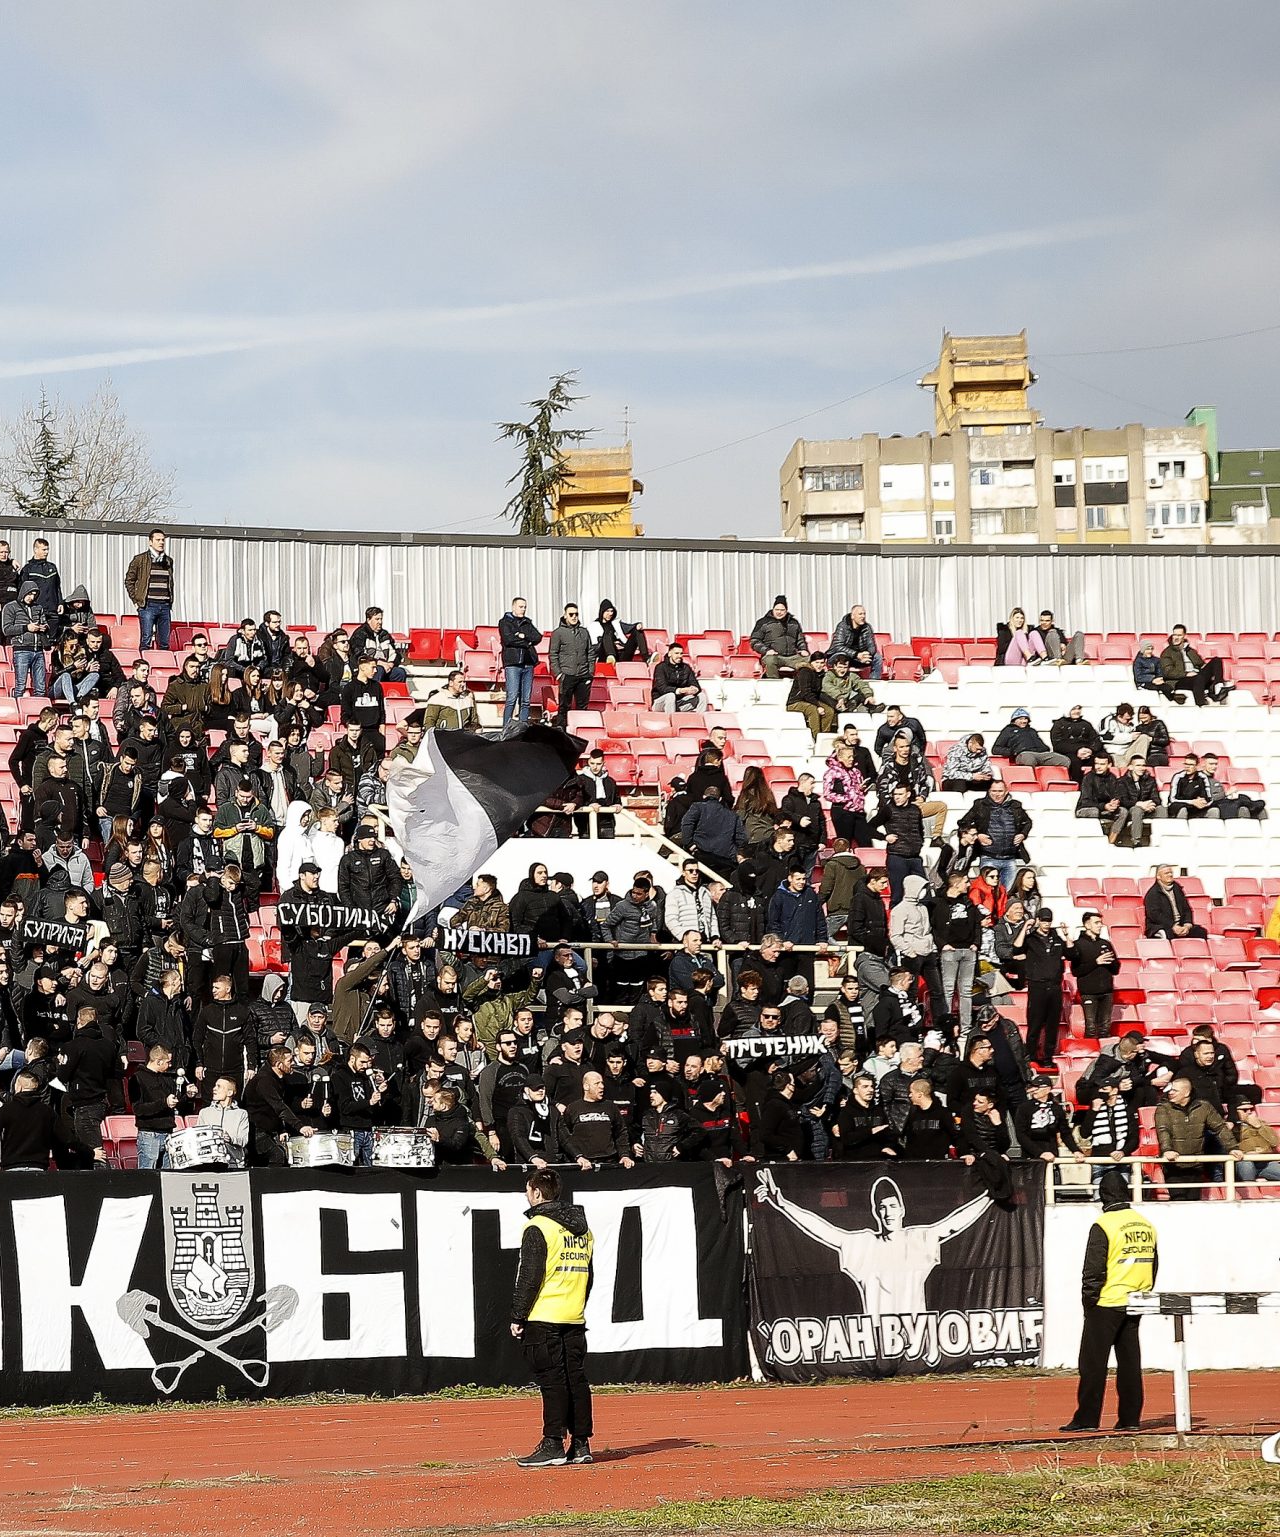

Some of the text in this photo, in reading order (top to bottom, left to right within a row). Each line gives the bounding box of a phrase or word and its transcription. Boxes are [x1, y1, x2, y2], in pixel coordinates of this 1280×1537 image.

[278, 902, 384, 935] СУБОТИЦА
[1124, 1230, 1153, 1244] NIFON
[261, 1186, 724, 1363] БГД
[879, 1307, 1044, 1367] ВУЈОВИЋ
